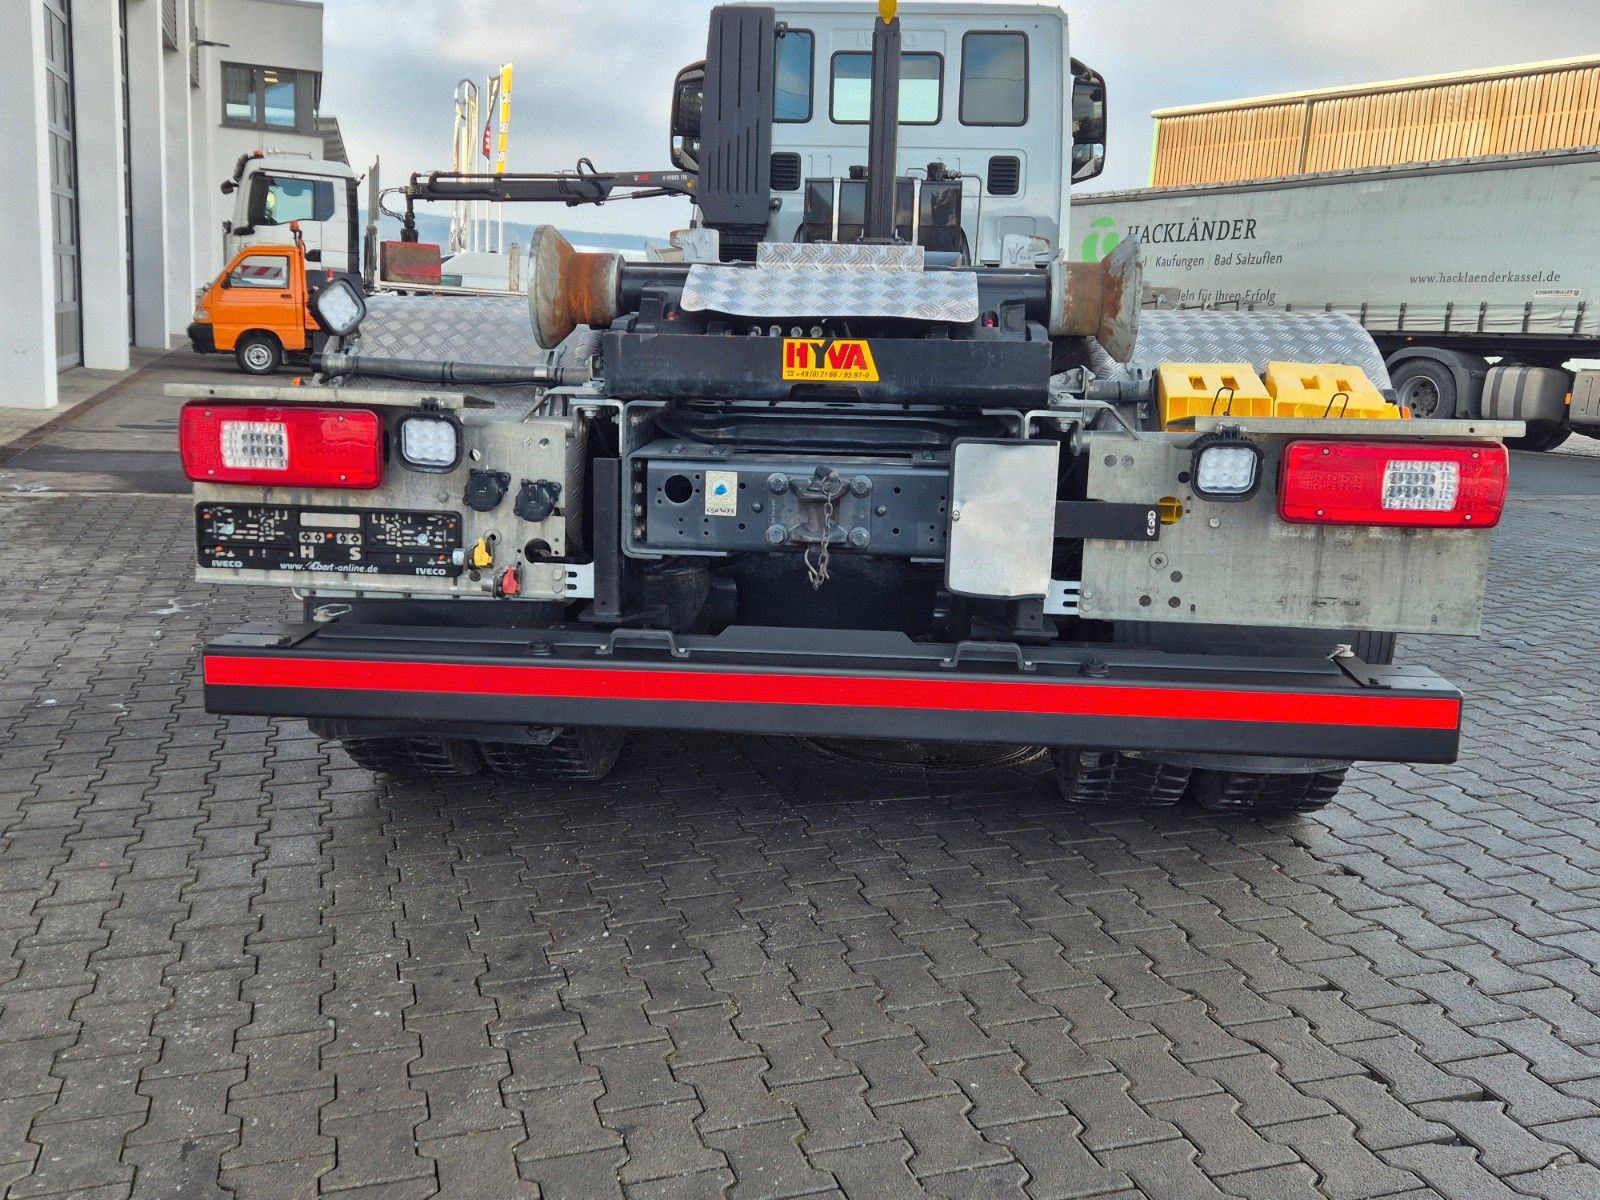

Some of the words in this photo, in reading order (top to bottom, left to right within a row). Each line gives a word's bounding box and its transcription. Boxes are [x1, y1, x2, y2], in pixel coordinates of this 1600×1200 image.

[1155, 254, 1205, 271] Kaufungen
[1214, 252, 1233, 266] Bad
[1236, 251, 1283, 265] Salzuflen
[1409, 270, 1561, 284] www.hacklaenderkassel.de
[1198, 288, 1212, 302] für
[1215, 288, 1242, 301] Ihren
[1243, 288, 1276, 306] Erfolg
[786, 341, 868, 370] HYVA
[211, 559, 243, 568] IVECO
[415, 567, 446, 576] IVECO
